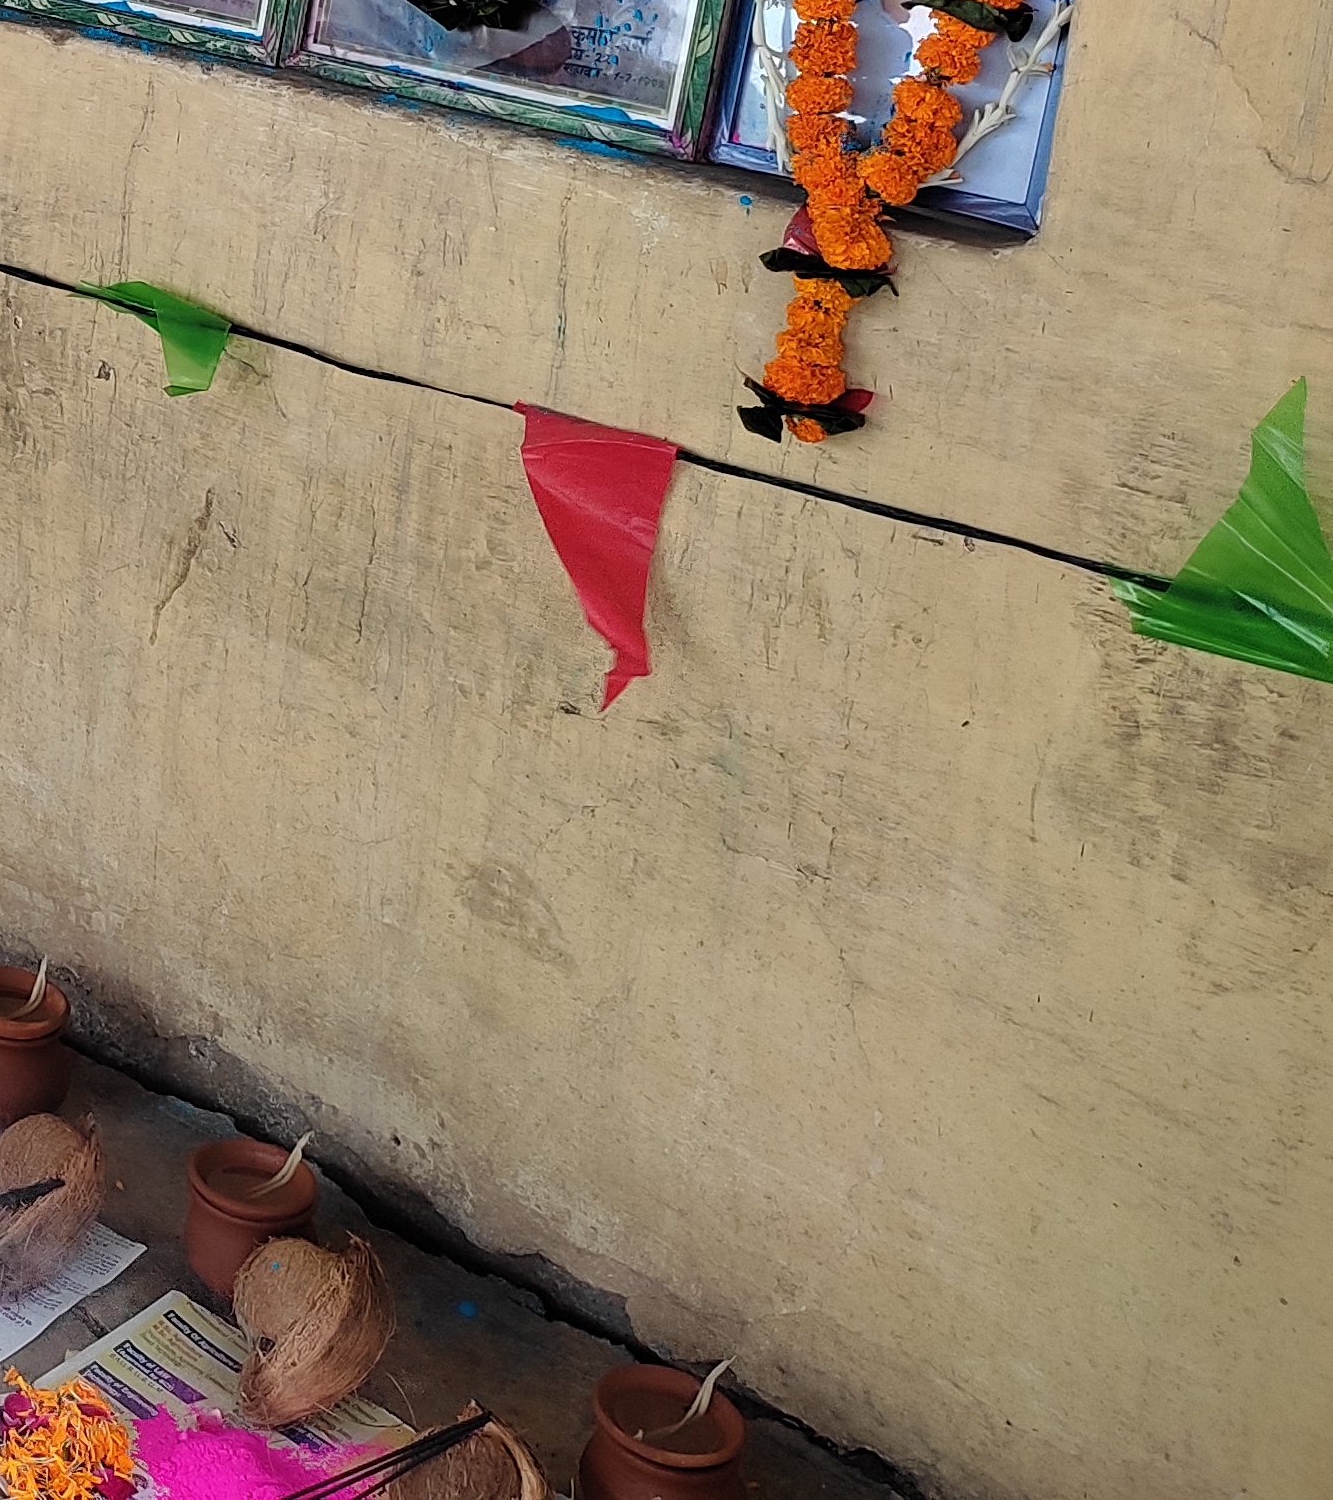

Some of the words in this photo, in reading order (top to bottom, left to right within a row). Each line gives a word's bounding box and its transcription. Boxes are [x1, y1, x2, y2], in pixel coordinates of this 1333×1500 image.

[166, 1311, 193, 1335] Faculty
[121, 1341, 148, 1365] Faculty
[89, 1362, 116, 1385] Faculty
